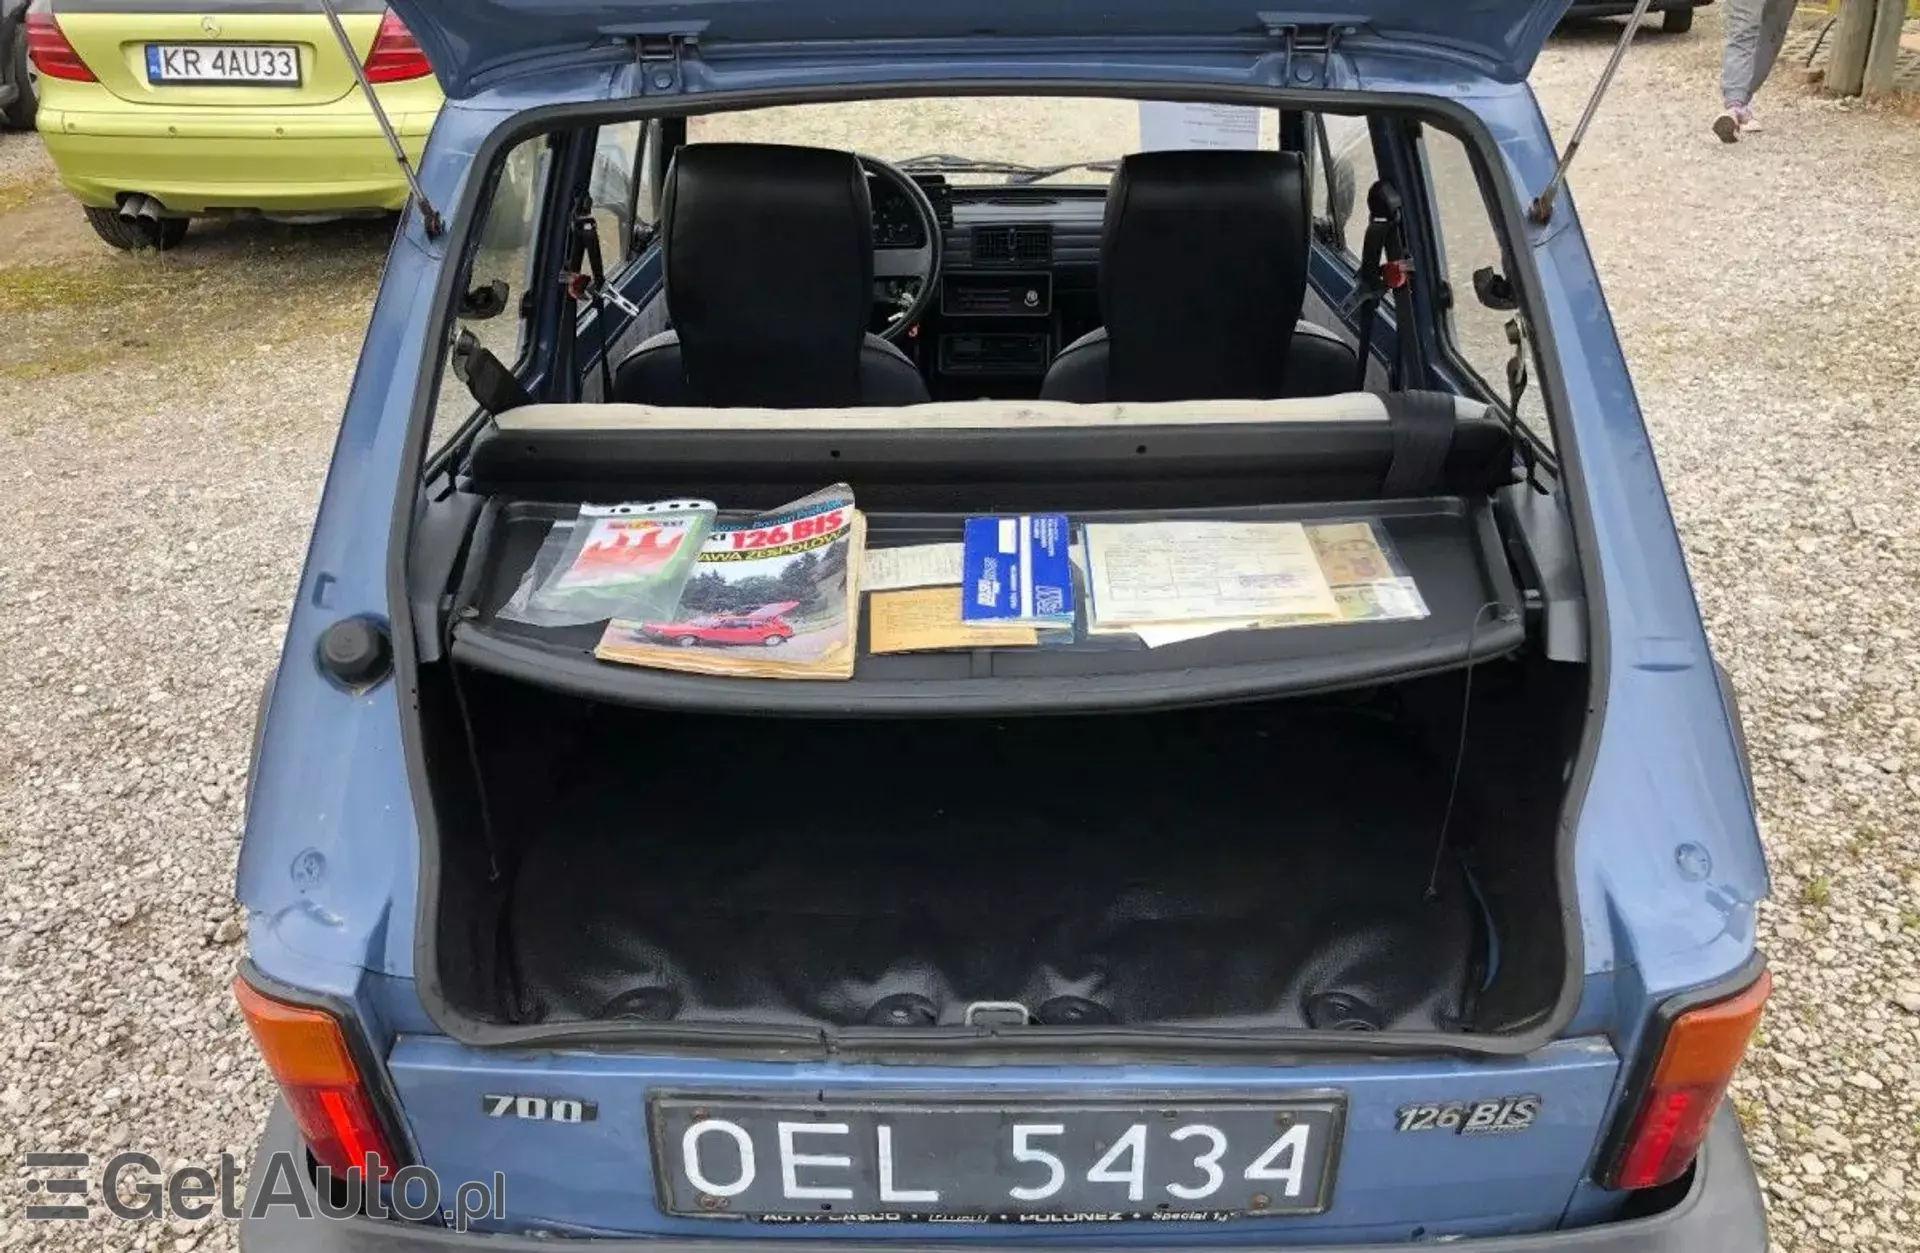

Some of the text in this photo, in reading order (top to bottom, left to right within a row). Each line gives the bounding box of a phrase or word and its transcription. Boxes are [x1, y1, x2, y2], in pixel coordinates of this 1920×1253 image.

[163, 49, 292, 76] KR 4AU33
[732, 526, 790, 550] 126
[792, 510, 844, 540] BIS
[484, 1094, 584, 1123] 700
[1399, 1098, 1540, 1132] 126 BIS
[682, 1119, 1310, 1203] OEL 5434
